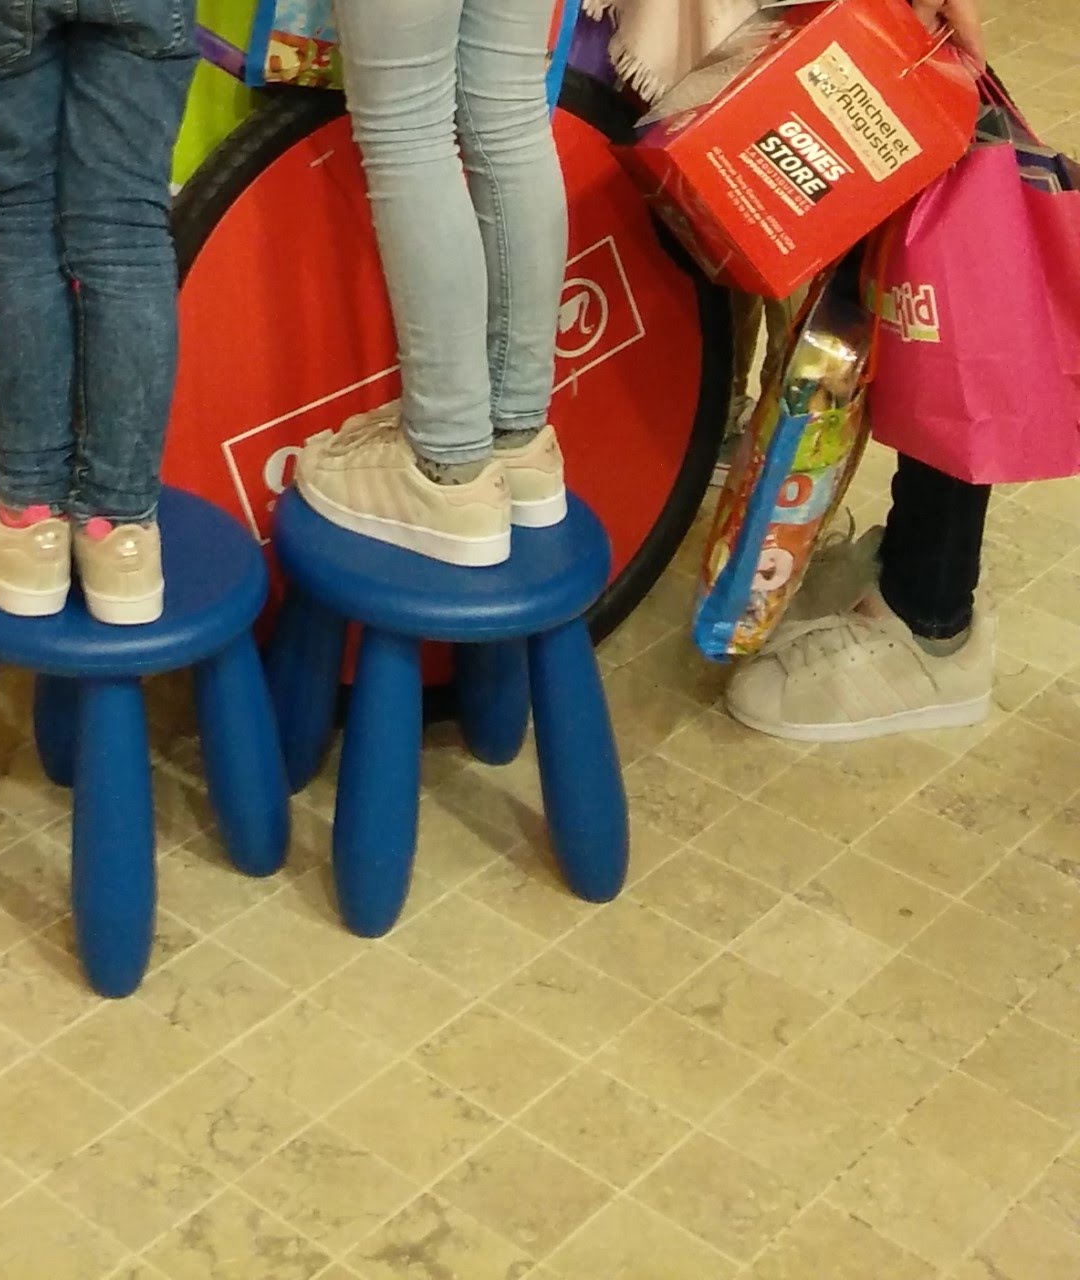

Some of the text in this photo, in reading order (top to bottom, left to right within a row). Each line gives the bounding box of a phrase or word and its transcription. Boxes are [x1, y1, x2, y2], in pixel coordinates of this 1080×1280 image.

[778, 121, 846, 182] GONES
[836, 93, 899, 170] Augustin
[849, 82, 897, 139] Michel
[892, 137, 909, 157] et
[759, 136, 827, 195] STORE
